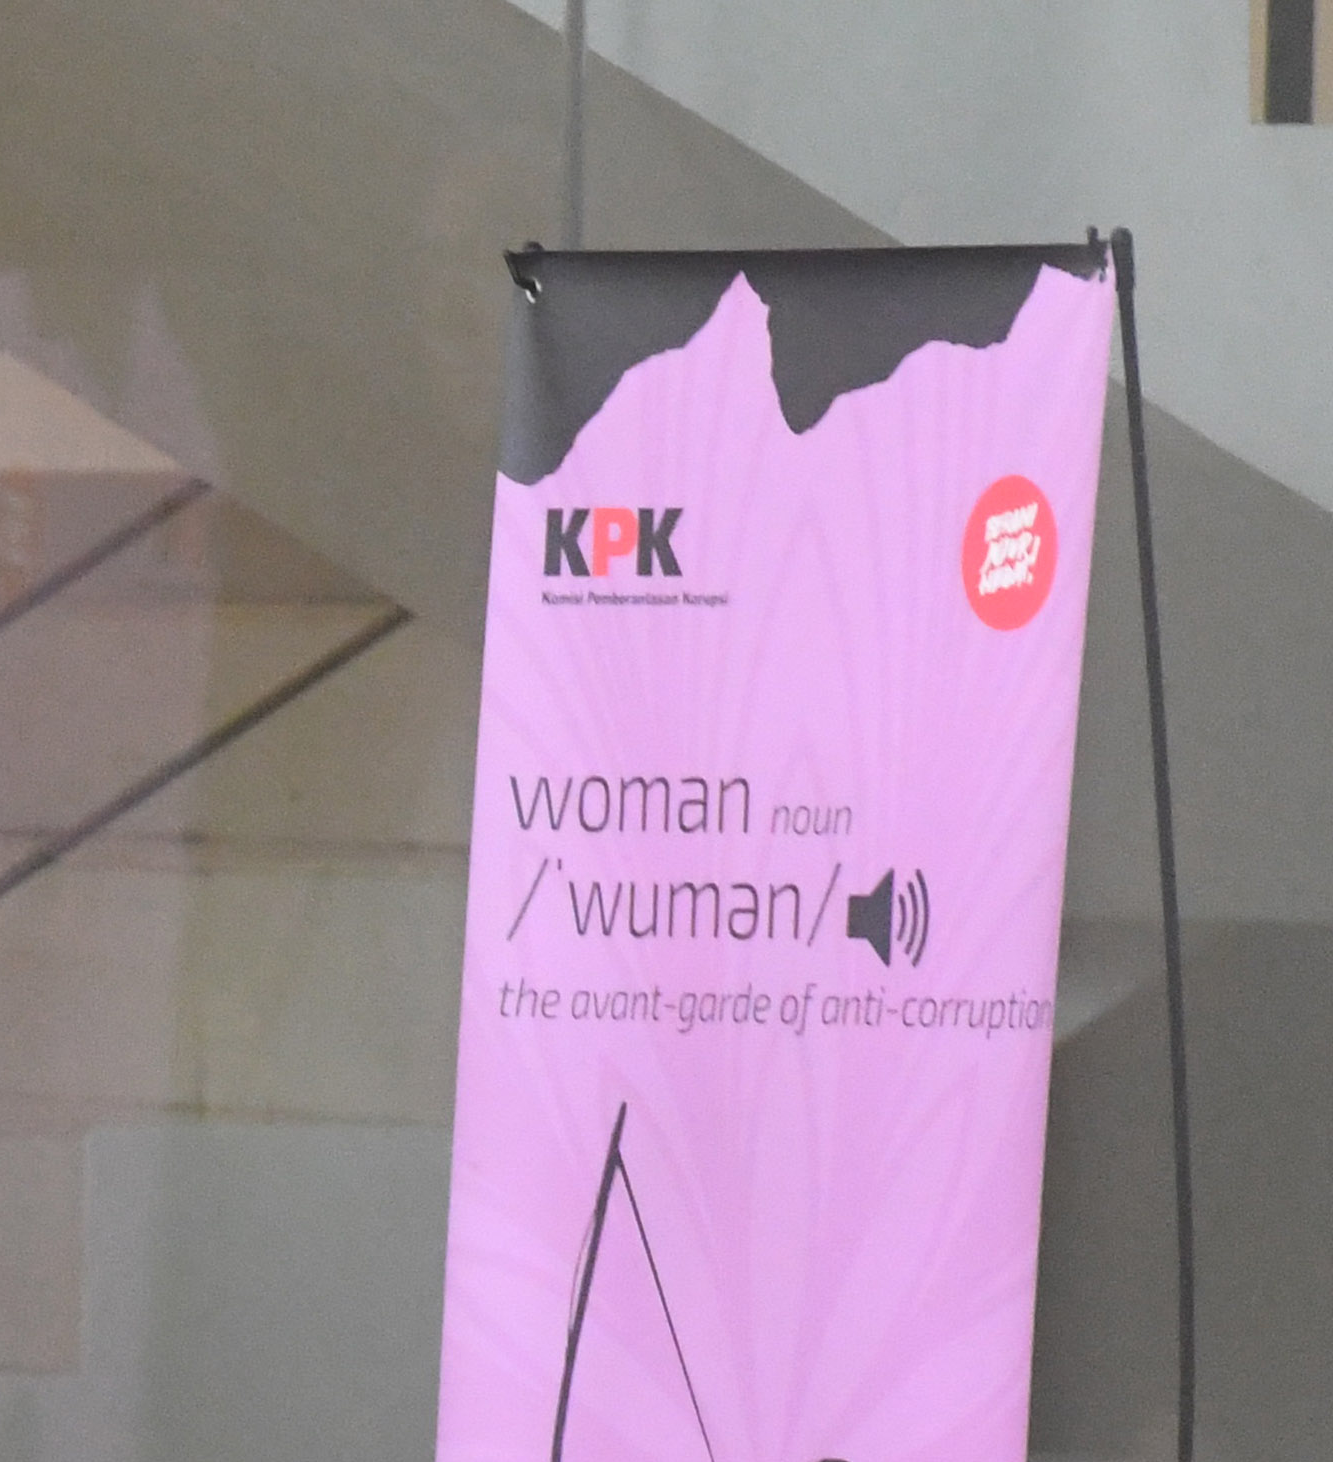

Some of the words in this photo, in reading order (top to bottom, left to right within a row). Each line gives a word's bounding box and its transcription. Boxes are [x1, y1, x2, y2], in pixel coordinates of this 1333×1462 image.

[543, 508, 684, 577] KPK
[509, 774, 751, 834] woman
[769, 804, 853, 836] noun
[499, 977, 562, 1019] the
[570, 982, 772, 1034] avant-garde
[779, 982, 818, 1036] of
